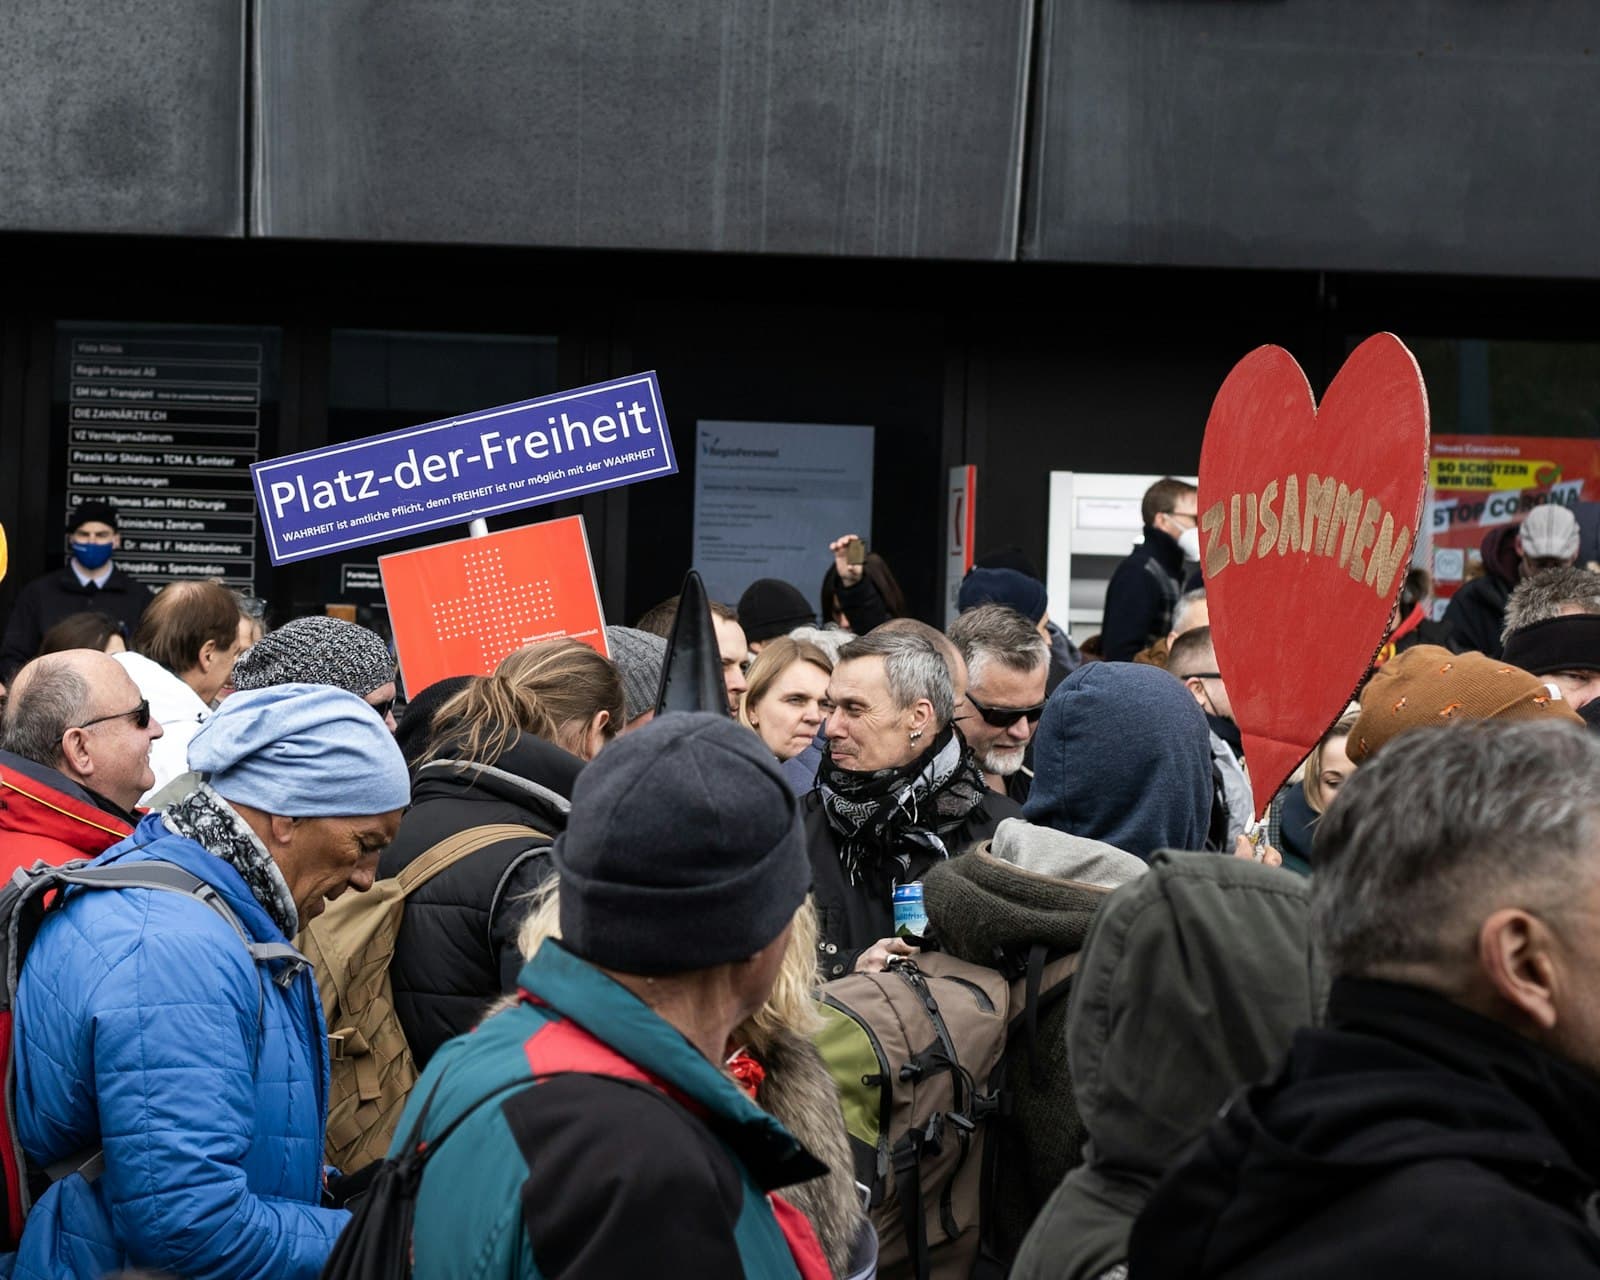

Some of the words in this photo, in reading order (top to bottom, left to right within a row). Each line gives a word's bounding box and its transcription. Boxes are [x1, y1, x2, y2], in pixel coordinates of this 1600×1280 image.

[102, 365, 141, 376] Personal
[143, 367, 157, 377] AG
[110, 387, 154, 399] Transplant
[74, 408, 91, 418] DIE
[74, 430, 87, 440] VZ
[1465, 444, 1521, 456] Coronavirus
[73, 451, 103, 462] Praxis
[104, 452, 118, 463] für
[163, 454, 184, 465] TCM
[271, 401, 651, 518] Platz-der-Freiheit
[1437, 462, 1456, 473] SO
[1459, 461, 1529, 475] SCHÜTZEN
[102, 473, 170, 488] Versicherungen
[1437, 475, 1463, 486] WIR
[1465, 475, 1496, 487] UNS.
[72, 495, 84, 505] Dr
[108, 496, 142, 507] Thomas
[282, 523, 335, 543] WAHRHEIT
[337, 520, 348, 530] ist
[350, 510, 390, 528] amtliche
[391, 503, 424, 518] Pflicht,
[426, 497, 451, 509] denn
[452, 485, 493, 503] FREIHEIT
[495, 484, 507, 493] ist
[509, 480, 526, 490] nur
[528, 469, 566, 487] möglich
[567, 465, 584, 477] mit
[586, 462, 602, 473] der
[603, 448, 656, 468] WAHRHEIT
[1433, 502, 1486, 527] STOP
[165, 519, 205, 531] Zentrum
[1201, 473, 1410, 599] ZUSAMMEN
[168, 563, 226, 575] Sportmedizin
